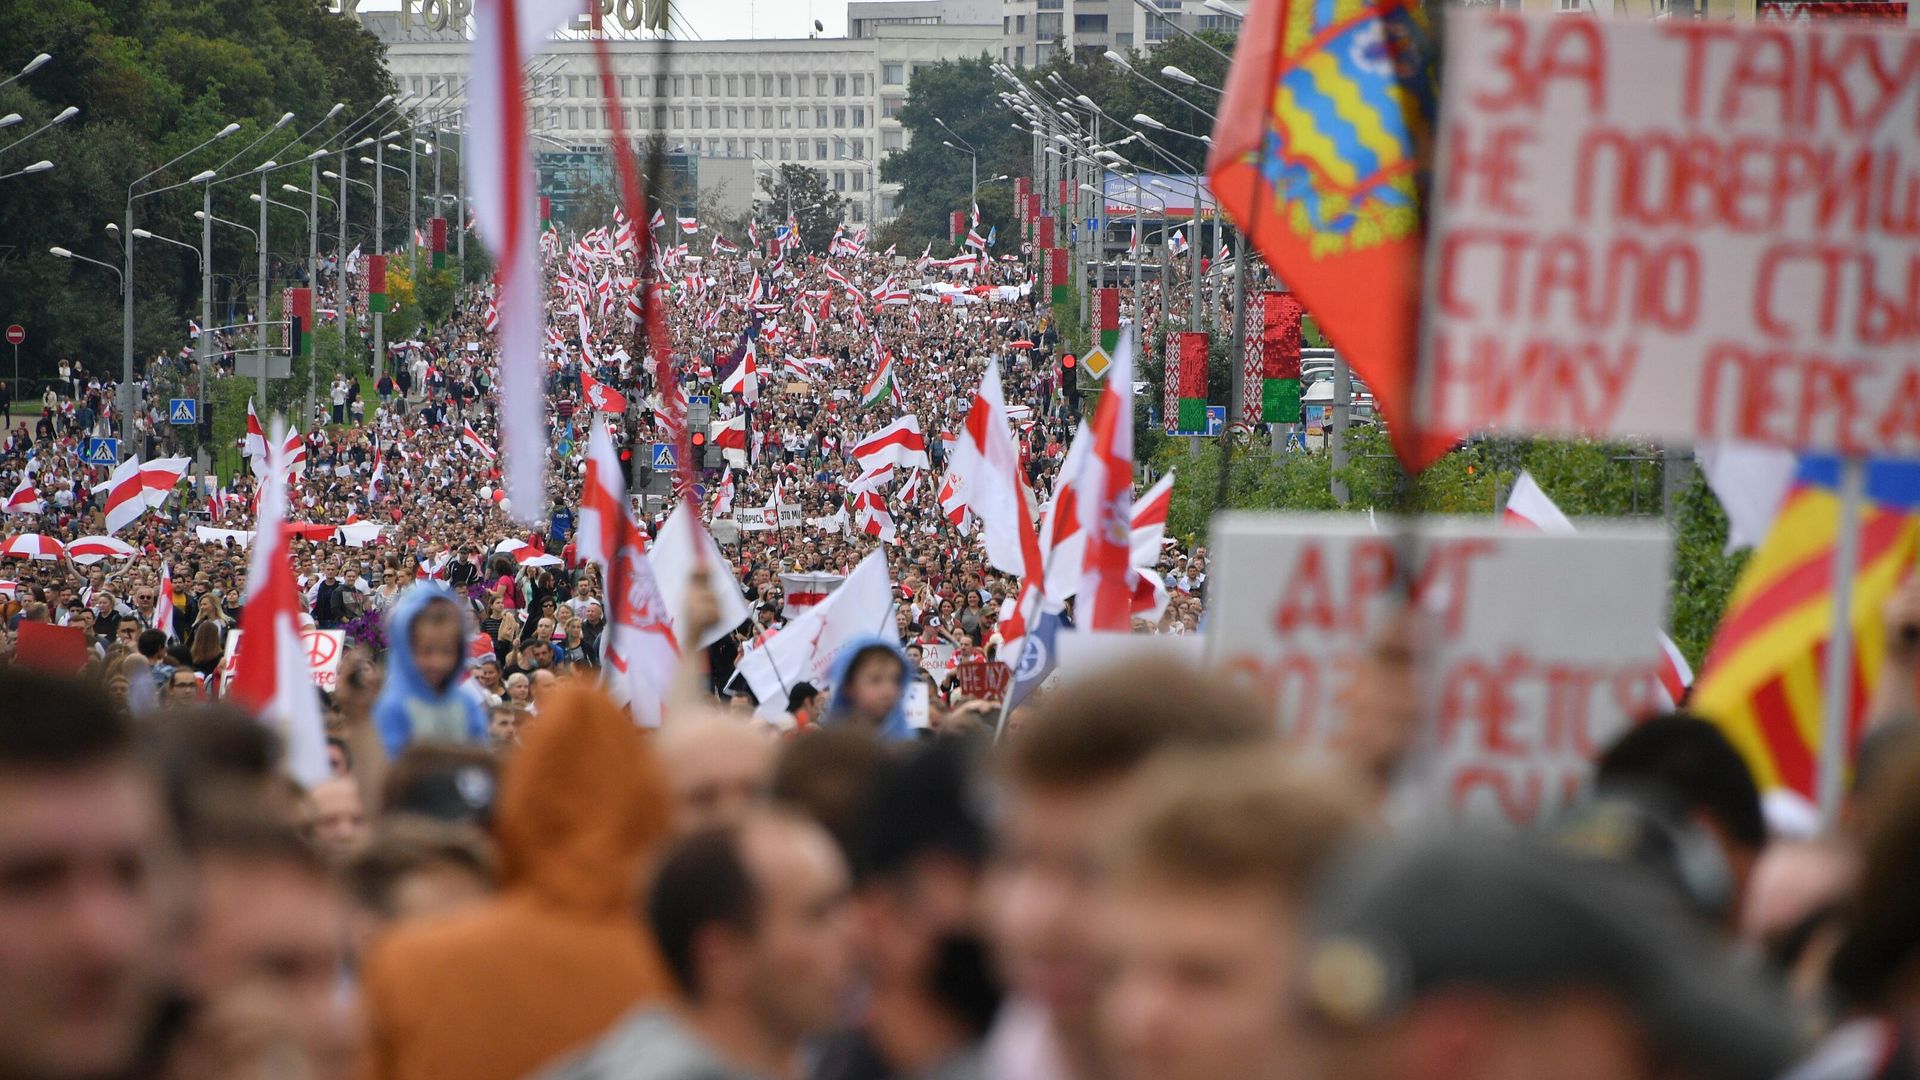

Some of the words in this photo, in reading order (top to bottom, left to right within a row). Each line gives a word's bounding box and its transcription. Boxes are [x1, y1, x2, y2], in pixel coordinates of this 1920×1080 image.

[401, 0, 473, 32] ГОР
[1472, 11, 1606, 117] ЗА
[1656, 21, 1920, 137] ТАКУ
[1447, 121, 1535, 218] НЕ
[1438, 229, 1702, 334] СТАЛО
[962, 665, 981, 691] НЕ
